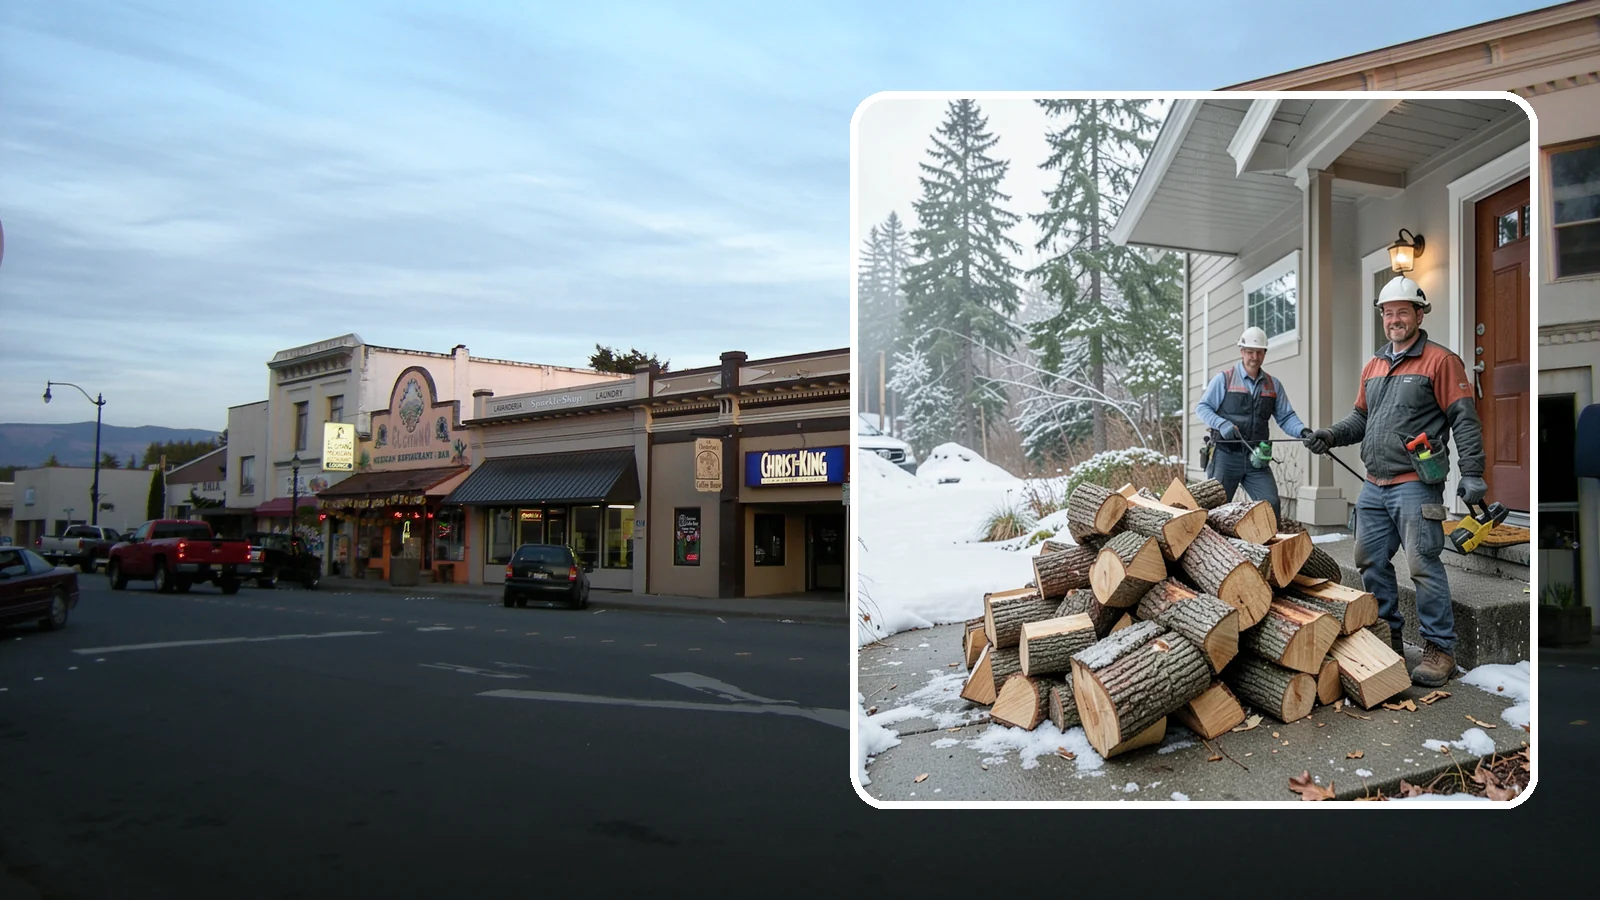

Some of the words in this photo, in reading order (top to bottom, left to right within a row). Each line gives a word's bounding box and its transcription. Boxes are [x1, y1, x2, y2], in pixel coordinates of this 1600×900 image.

[595, 389, 623, 400] LAUNDRY
[493, 402, 522, 412] LAVANDERIA
[391, 425, 401, 449] EL
[374, 454, 397, 464] MEXICAN
[398, 451, 434, 462] RESTAURANT
[437, 450, 450, 459] BAR
[761, 452, 797, 478] CHRIST
[799, 450, 828, 476] KING
[697, 480, 709, 489] Coffee
[710, 480, 722, 489] House
